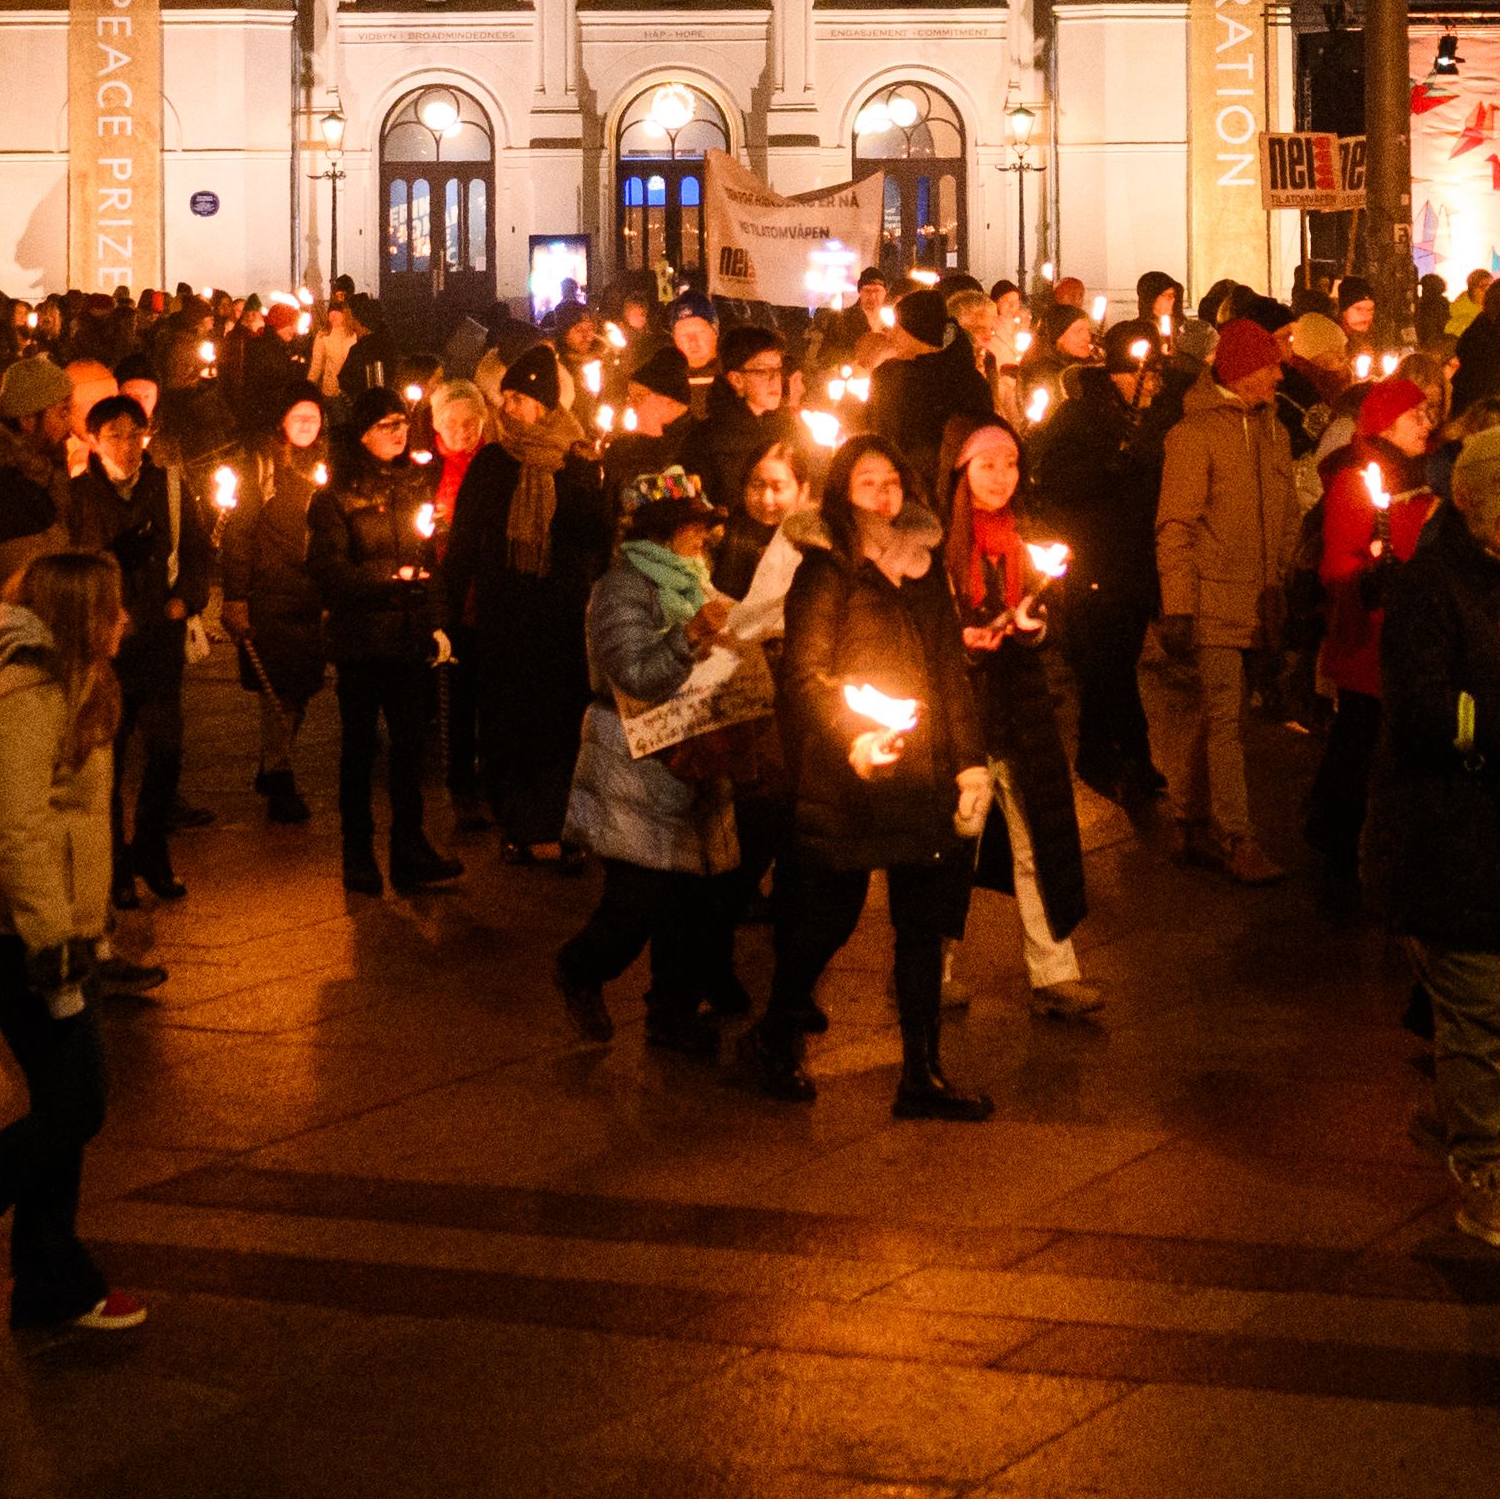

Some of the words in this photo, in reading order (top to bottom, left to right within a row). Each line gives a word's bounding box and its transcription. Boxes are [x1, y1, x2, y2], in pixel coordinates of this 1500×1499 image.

[358, 32, 397, 40] VIDSYN
[408, 30, 516, 40] BROADMINDEDNESS
[831, 29, 909, 37] ENGASJEMENT
[917, 28, 988, 37] COMMITMENT
[838, 191, 861, 209] NÅ
[97, 157, 134, 289] PRIZE
